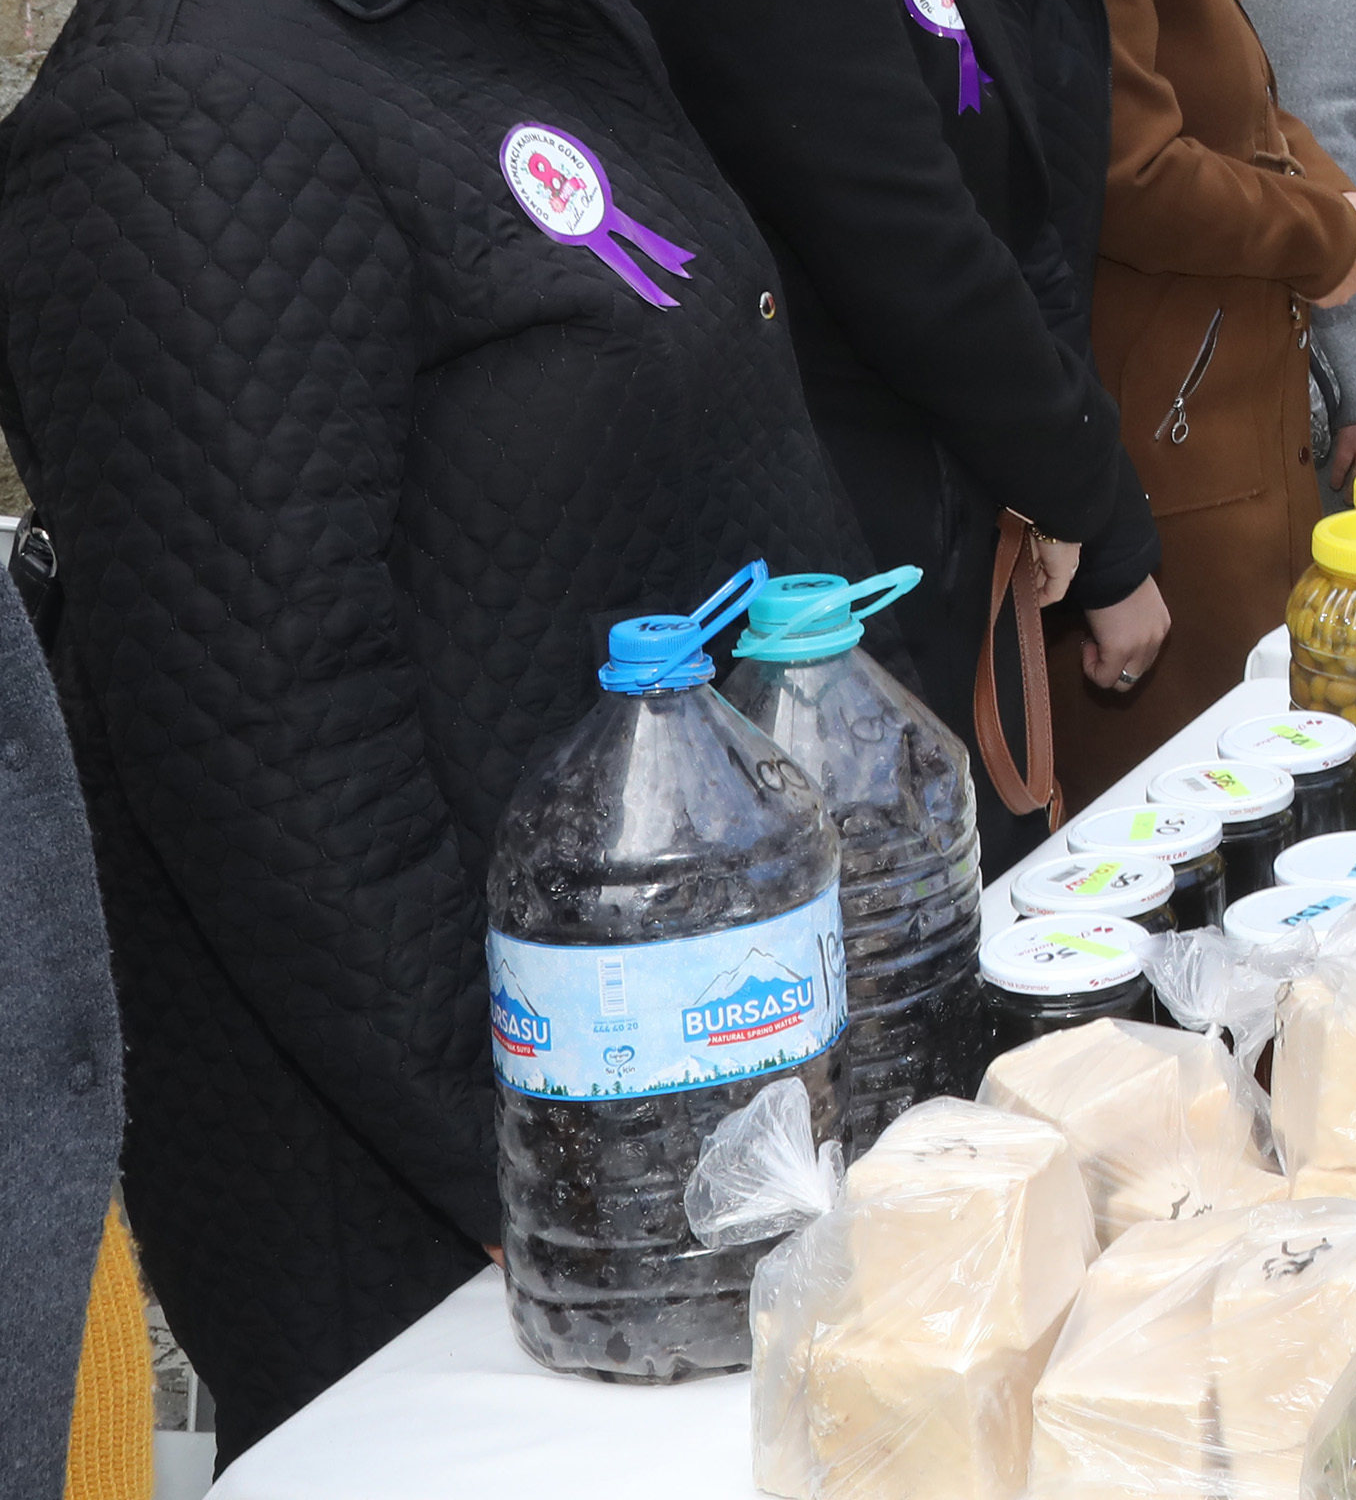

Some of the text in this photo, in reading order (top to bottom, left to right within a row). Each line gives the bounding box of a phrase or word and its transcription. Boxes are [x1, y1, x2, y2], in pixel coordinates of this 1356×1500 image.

[528, 152, 566, 198] 8
[636, 621, 696, 633] 100
[727, 744, 811, 802] 100
[490, 1004, 548, 1044] URSASU
[593, 1022, 610, 1033] 444
[613, 1022, 625, 1033] 40
[627, 1021, 639, 1031] 20
[686, 981, 812, 1036] BURSASU
[711, 1015, 799, 1044] NATURAL SPRING WATER
